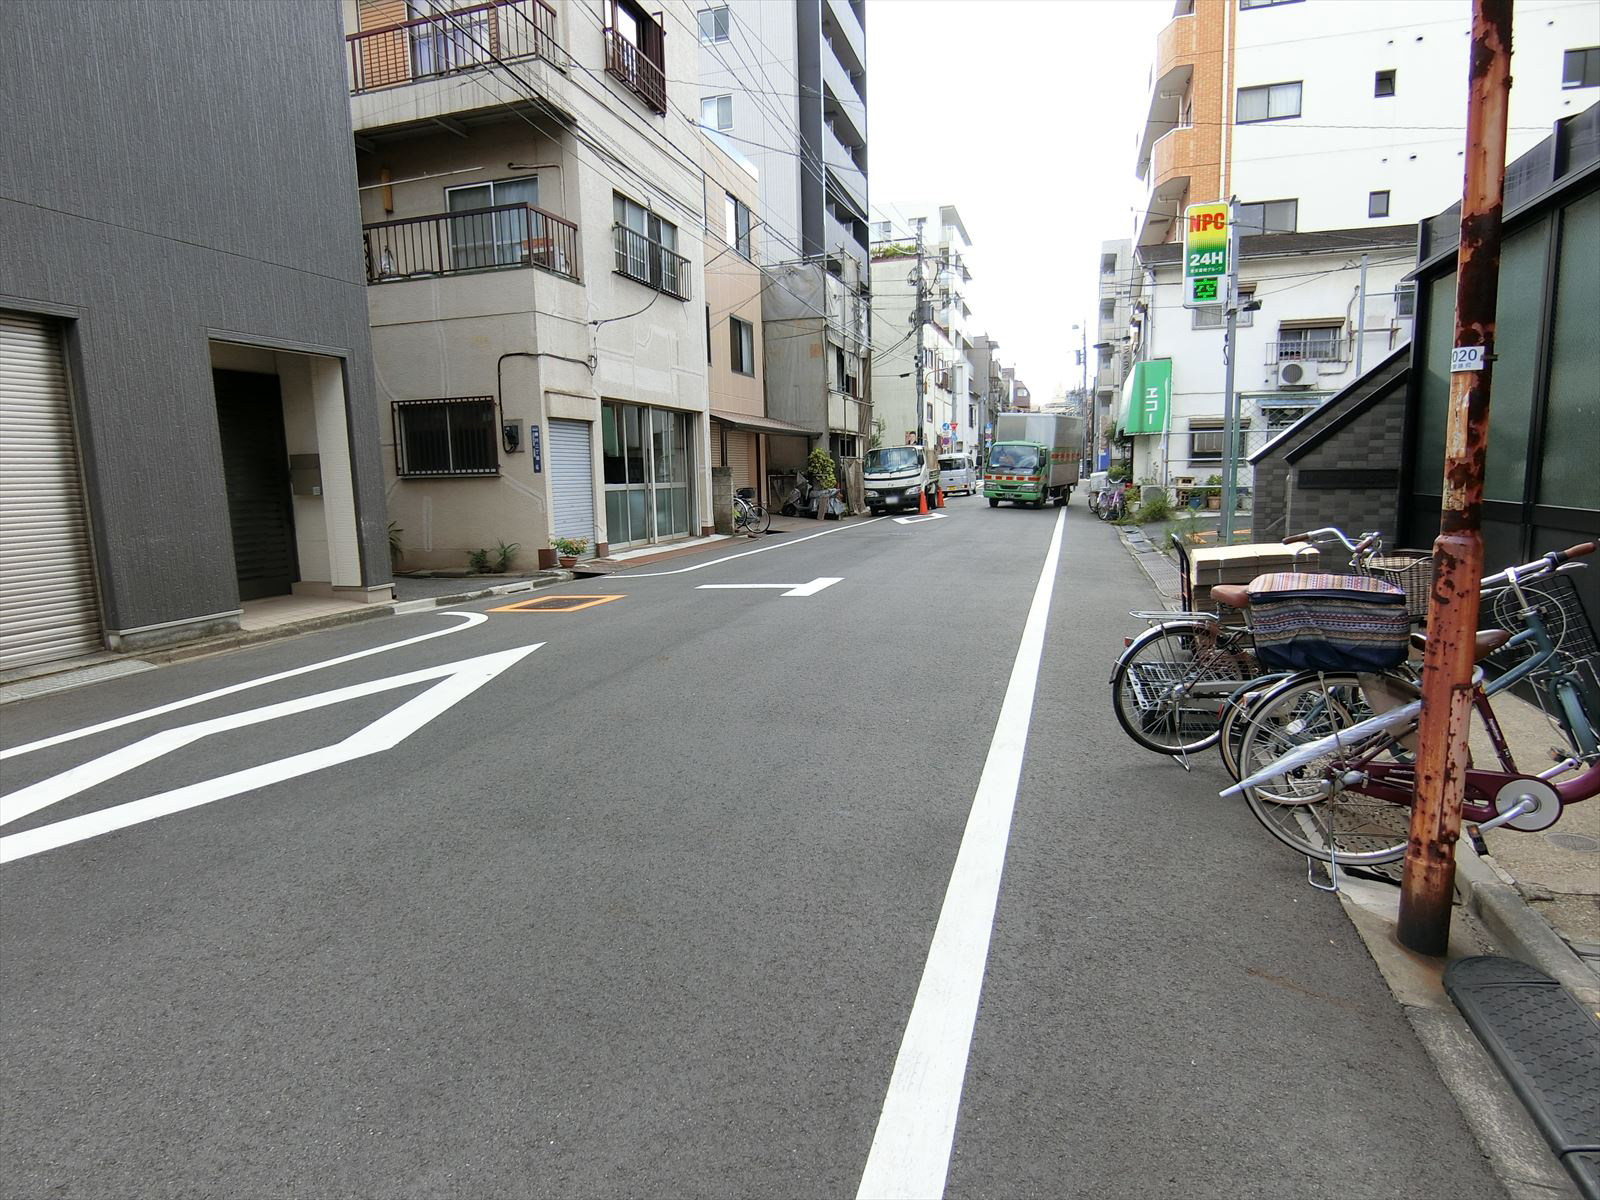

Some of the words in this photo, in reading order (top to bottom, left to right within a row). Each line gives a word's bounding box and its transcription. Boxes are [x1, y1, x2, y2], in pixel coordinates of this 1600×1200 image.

[1189, 212, 1225, 232] NPC
[1190, 252, 1223, 266] 24H
[1453, 348, 1477, 363] 020
[1144, 387, 1158, 425] エコー
